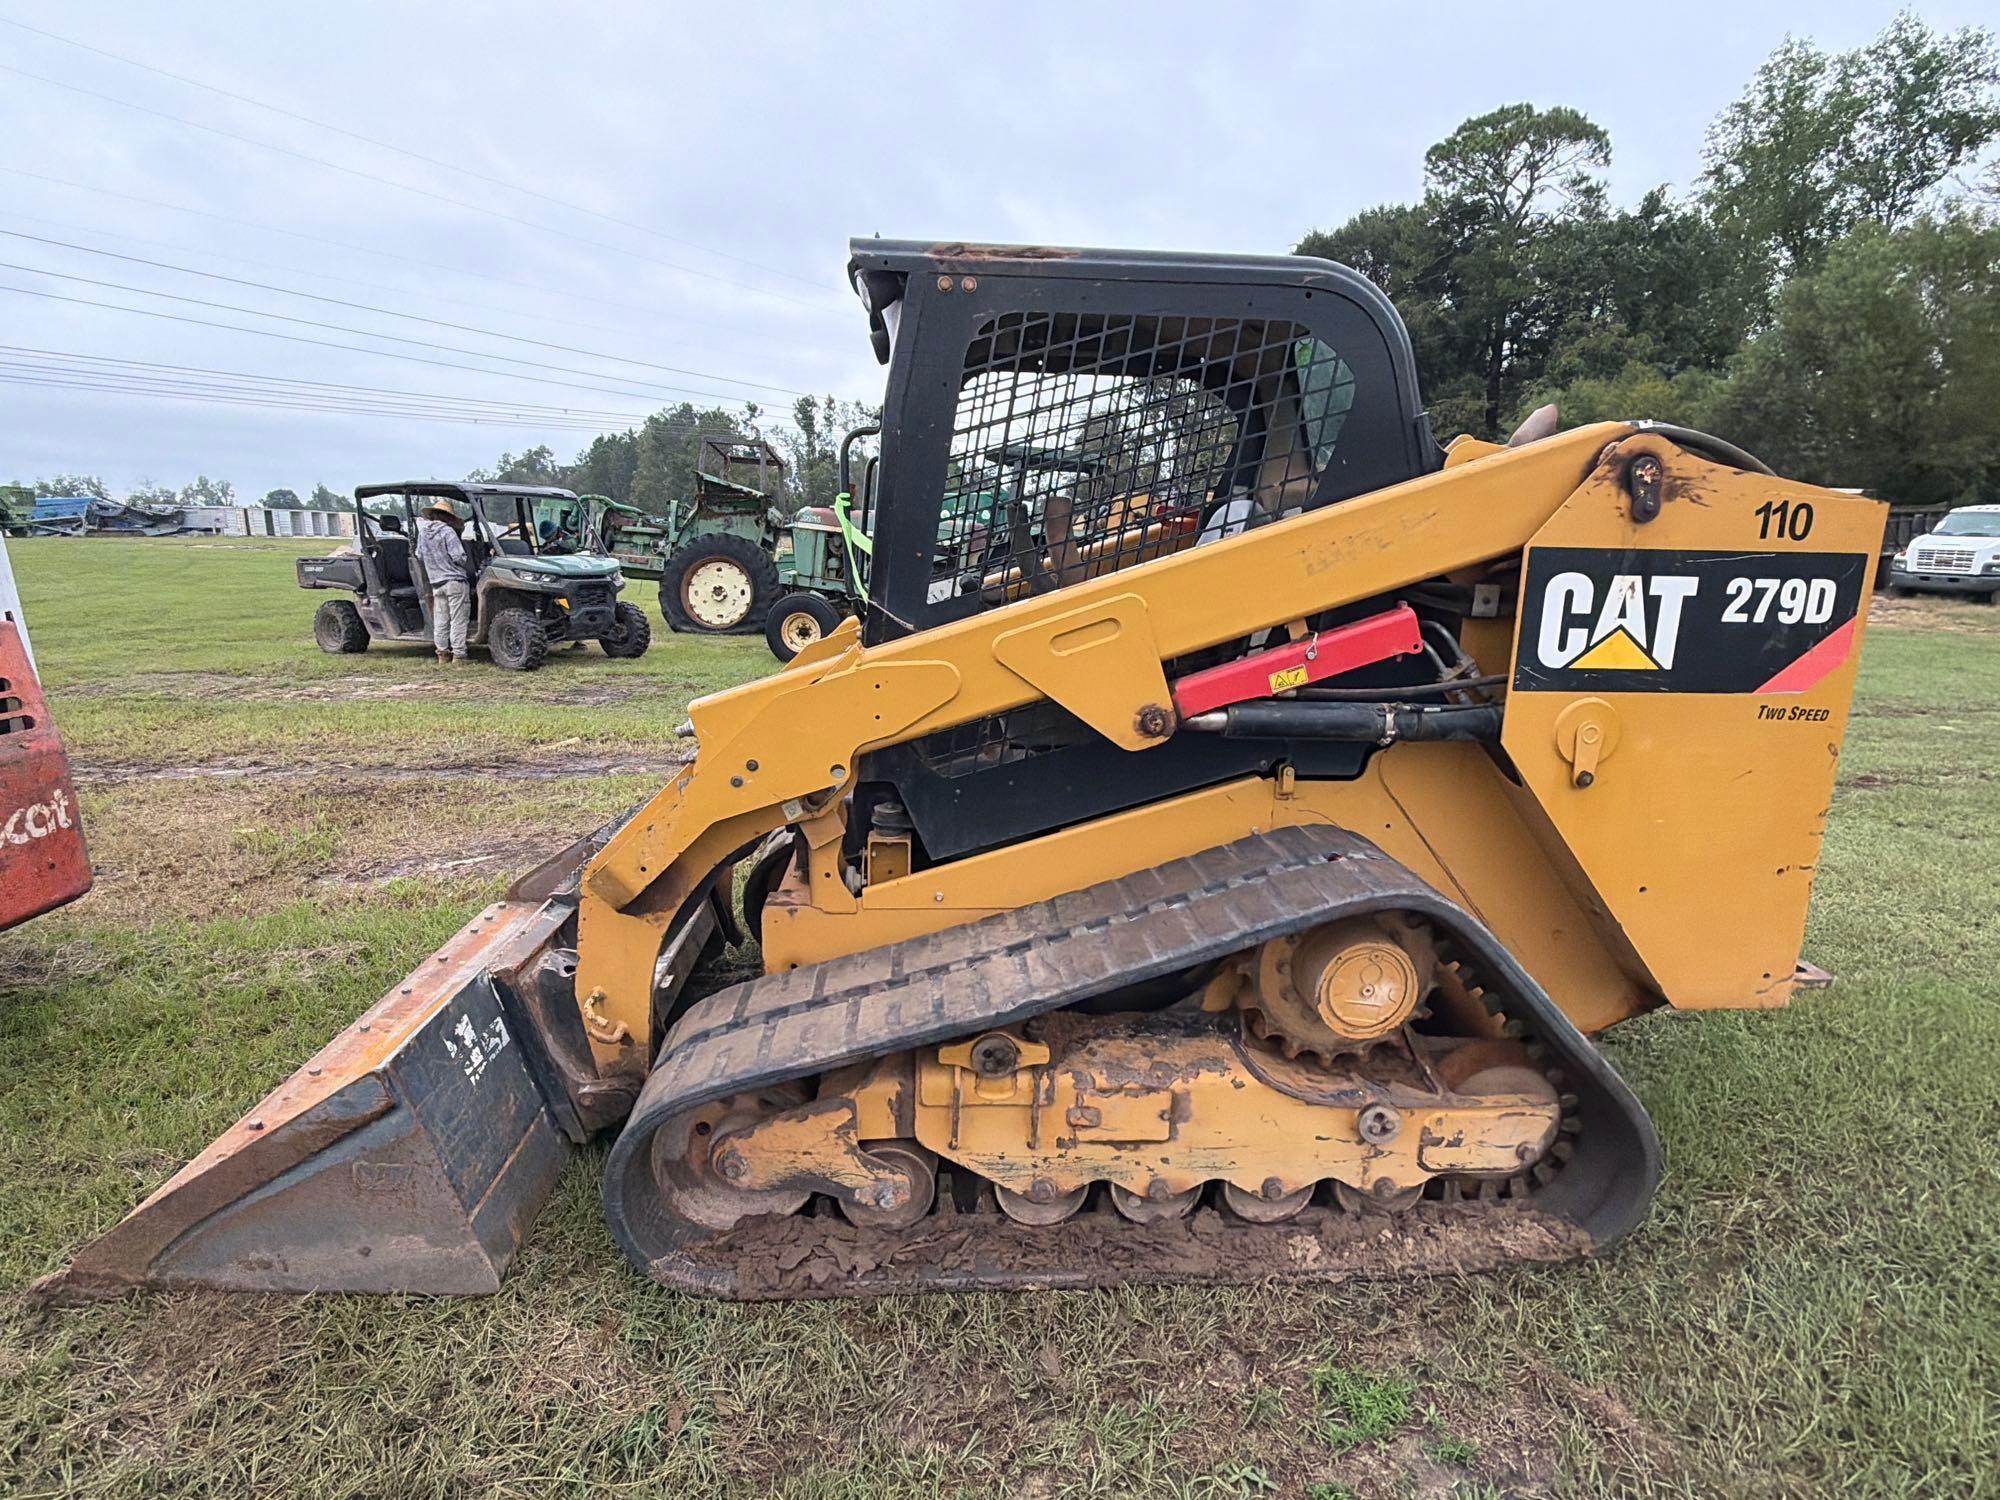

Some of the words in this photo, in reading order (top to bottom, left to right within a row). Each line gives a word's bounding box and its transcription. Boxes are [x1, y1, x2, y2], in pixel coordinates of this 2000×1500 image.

[1755, 500, 1814, 541] 110
[1537, 572, 1699, 670] CAT
[1721, 577, 1837, 624] 279D
[0, 788, 72, 849] cat
